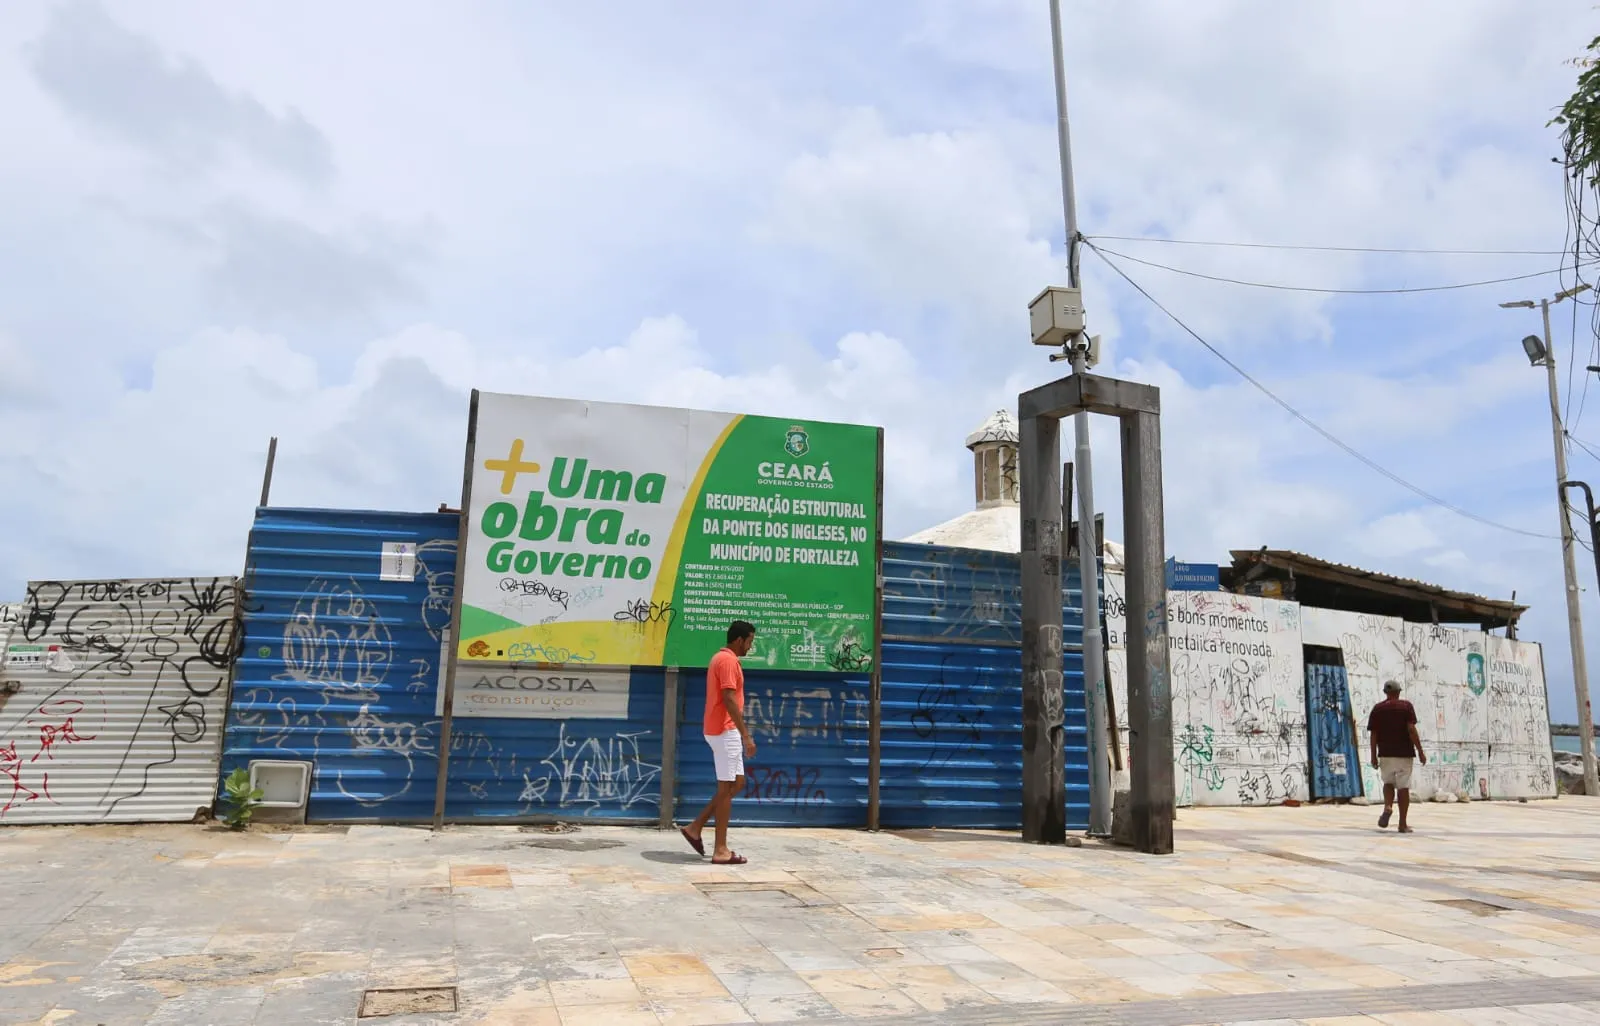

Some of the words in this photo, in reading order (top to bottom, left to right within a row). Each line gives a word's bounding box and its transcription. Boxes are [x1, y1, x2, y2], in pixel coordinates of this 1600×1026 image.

[548, 456, 666, 504] Uma
[758, 461, 834, 482] CEARÁ
[757, 478, 793, 487] GOVERNO
[806, 482, 834, 490] ESTADO
[706, 493, 790, 518] RECUPERAÇÃO
[792, 499, 867, 520] ESTRUTURAL
[481, 490, 624, 545] obra
[624, 529, 651, 547] do
[702, 518, 720, 535] DA
[722, 519, 762, 538] PONTE
[764, 522, 789, 540] DOS
[791, 523, 848, 545] INGLESES,
[850, 526, 867, 543] NO
[486, 540, 652, 580] Governo
[710, 541, 773, 563] MUNICÍPIO
[775, 546, 791, 564] DE
[793, 548, 860, 566] FORTALEZA
[684, 606, 721, 614] INFORMAÇÕES
[734, 600, 782, 608] SUPERINTENDÊNCIA
[1178, 605, 1206, 626] bons
[1209, 614, 1269, 633] momentos
[1220, 639, 1276, 658] renovada.
[1490, 656, 1524, 675] GOVERNO
[472, 675, 599, 692] ACOSTA
